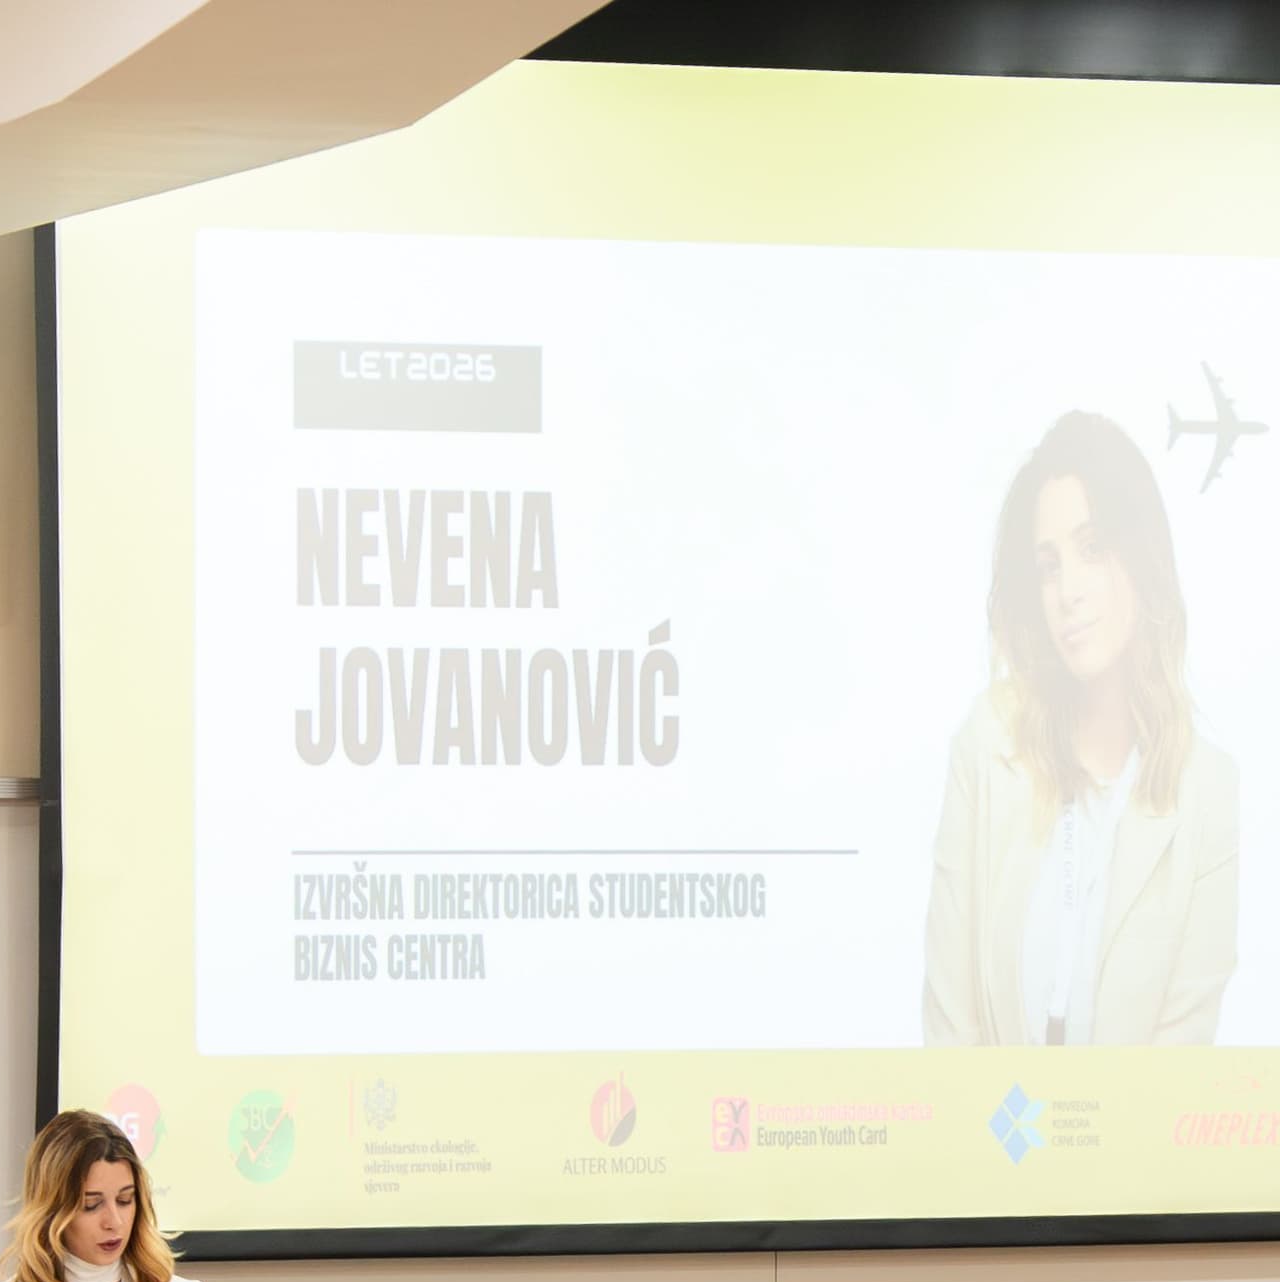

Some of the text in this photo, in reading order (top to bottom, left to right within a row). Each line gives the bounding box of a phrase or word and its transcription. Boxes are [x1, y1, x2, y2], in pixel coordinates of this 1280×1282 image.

[338, 349, 497, 383] LET2026
[295, 487, 560, 609] NEVENA
[294, 617, 680, 768] JOVANOVIĆ
[293, 861, 767, 921] IZVRŠNA DIREKTORICA STUDENTSKOG
[293, 933, 486, 982] BIZNIS CENTRA
[756, 1125, 888, 1150] European Youth Card
[562, 1156, 667, 1176] ALTER MODUS
